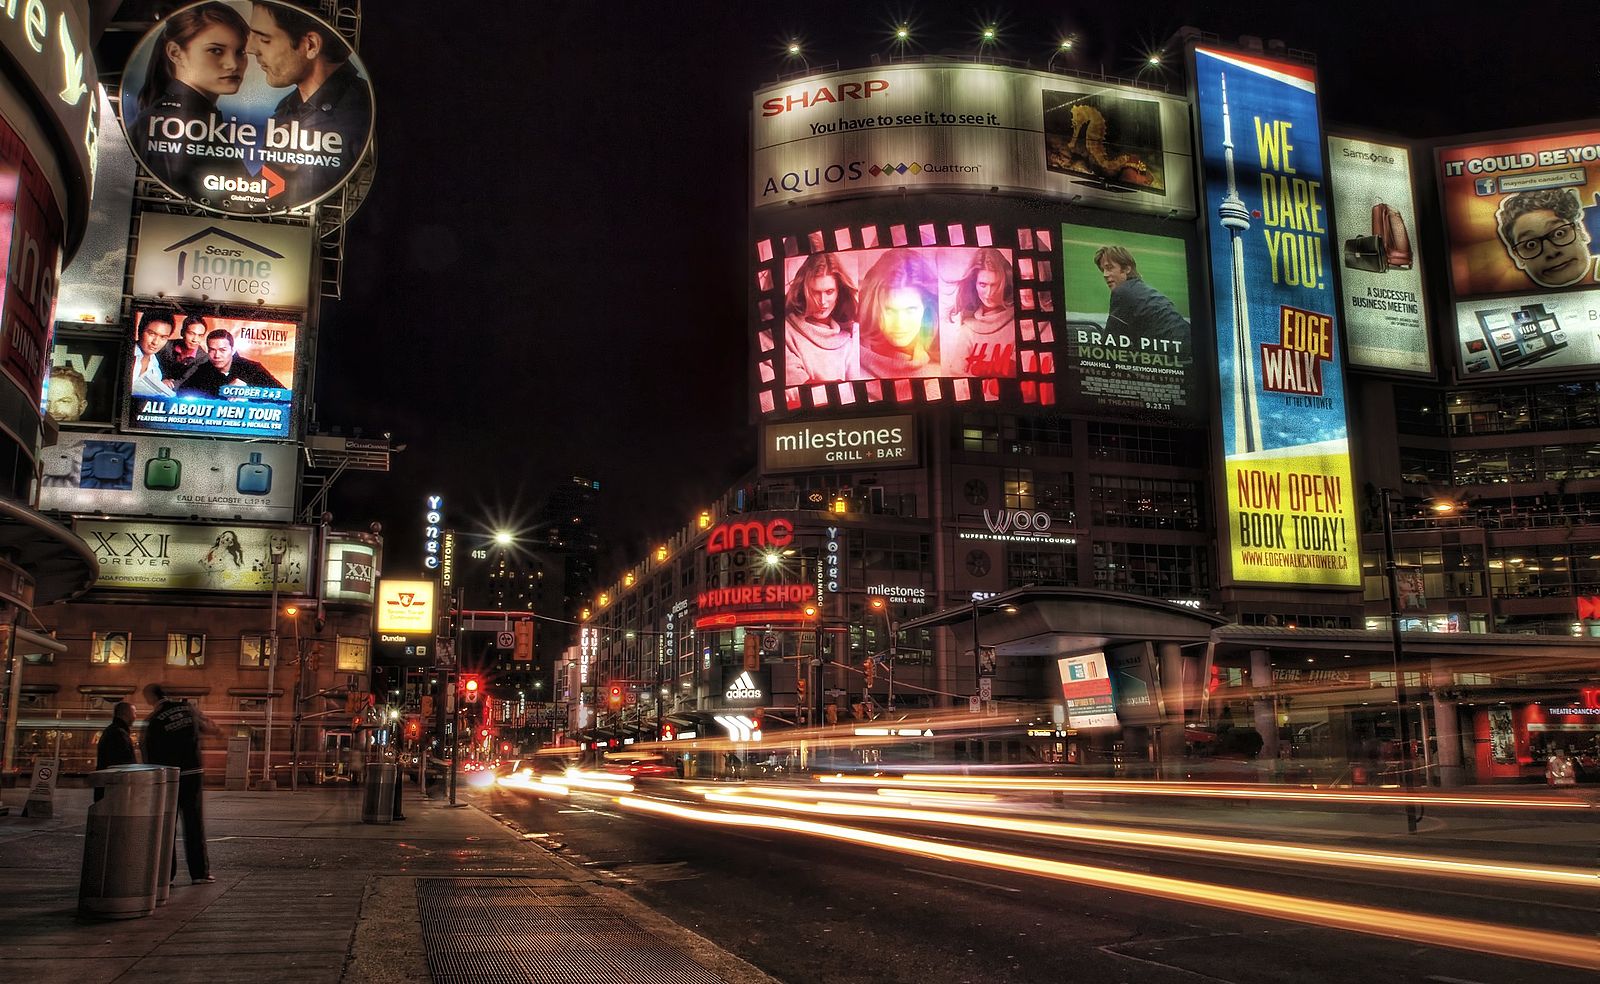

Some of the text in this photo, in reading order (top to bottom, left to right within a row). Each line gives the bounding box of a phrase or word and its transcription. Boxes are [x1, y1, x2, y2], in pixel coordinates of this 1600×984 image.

[762, 79, 889, 117] SHARP
[148, 112, 343, 154] rookie blue
[810, 111, 1000, 135] You have to see it, to see it.
[148, 140, 341, 168] NEW SEASON THURSDAYS
[1254, 116, 1296, 174] WE
[1342, 148, 1395, 164] Samsonite
[1445, 161, 1464, 176] IT
[1468, 153, 1536, 174] COULD
[1539, 149, 1569, 166] BE
[203, 174, 267, 194] Global
[763, 161, 979, 196] AQUOS Quattron
[231, 194, 266, 203] GlobalTV.com
[1260, 173, 1325, 234] DARE
[205, 245, 241, 257] Sears
[1263, 229, 1324, 290] YOU!
[193, 250, 272, 279] home
[191, 275, 270, 295] services
[1367, 287, 1417, 302] A SUCCESSFUL
[1352, 297, 1418, 314] BUSINESS MEETING
[241, 327, 289, 342] FALLSVIEW
[1077, 330, 1182, 353] BRAD PITT
[1283, 309, 1330, 358] EDGE
[1077, 346, 1184, 368] MONEYBALL
[1132, 366, 1158, 374] SEYMOUR
[1262, 347, 1319, 393] WALK
[223, 387, 260, 397] OCTOBER
[262, 389, 269, 397] 2
[275, 390, 282, 399] 3
[142, 401, 282, 421] ALL ABOUT MEN TOUR
[1145, 402, 1171, 410] 9.23.11
[776, 428, 903, 451] milestones
[826, 451, 862, 461] GRILL
[877, 449, 903, 458] BAR
[1237, 469, 1343, 514] NOW OPEN!
[425, 496, 442, 569] Yonge
[1239, 511, 1347, 552] BOOK TODAY!
[95, 556, 171, 567] OREVER
[443, 533, 453, 587] DOWNTOWN
[471, 550, 486, 559] 415
[827, 527, 839, 593] Yonge
[708, 585, 814, 607] FUTURE SHOP
[867, 584, 925, 597] milestones
[580, 628, 589, 683] FUTURE
[726, 688, 762, 699] adidas
